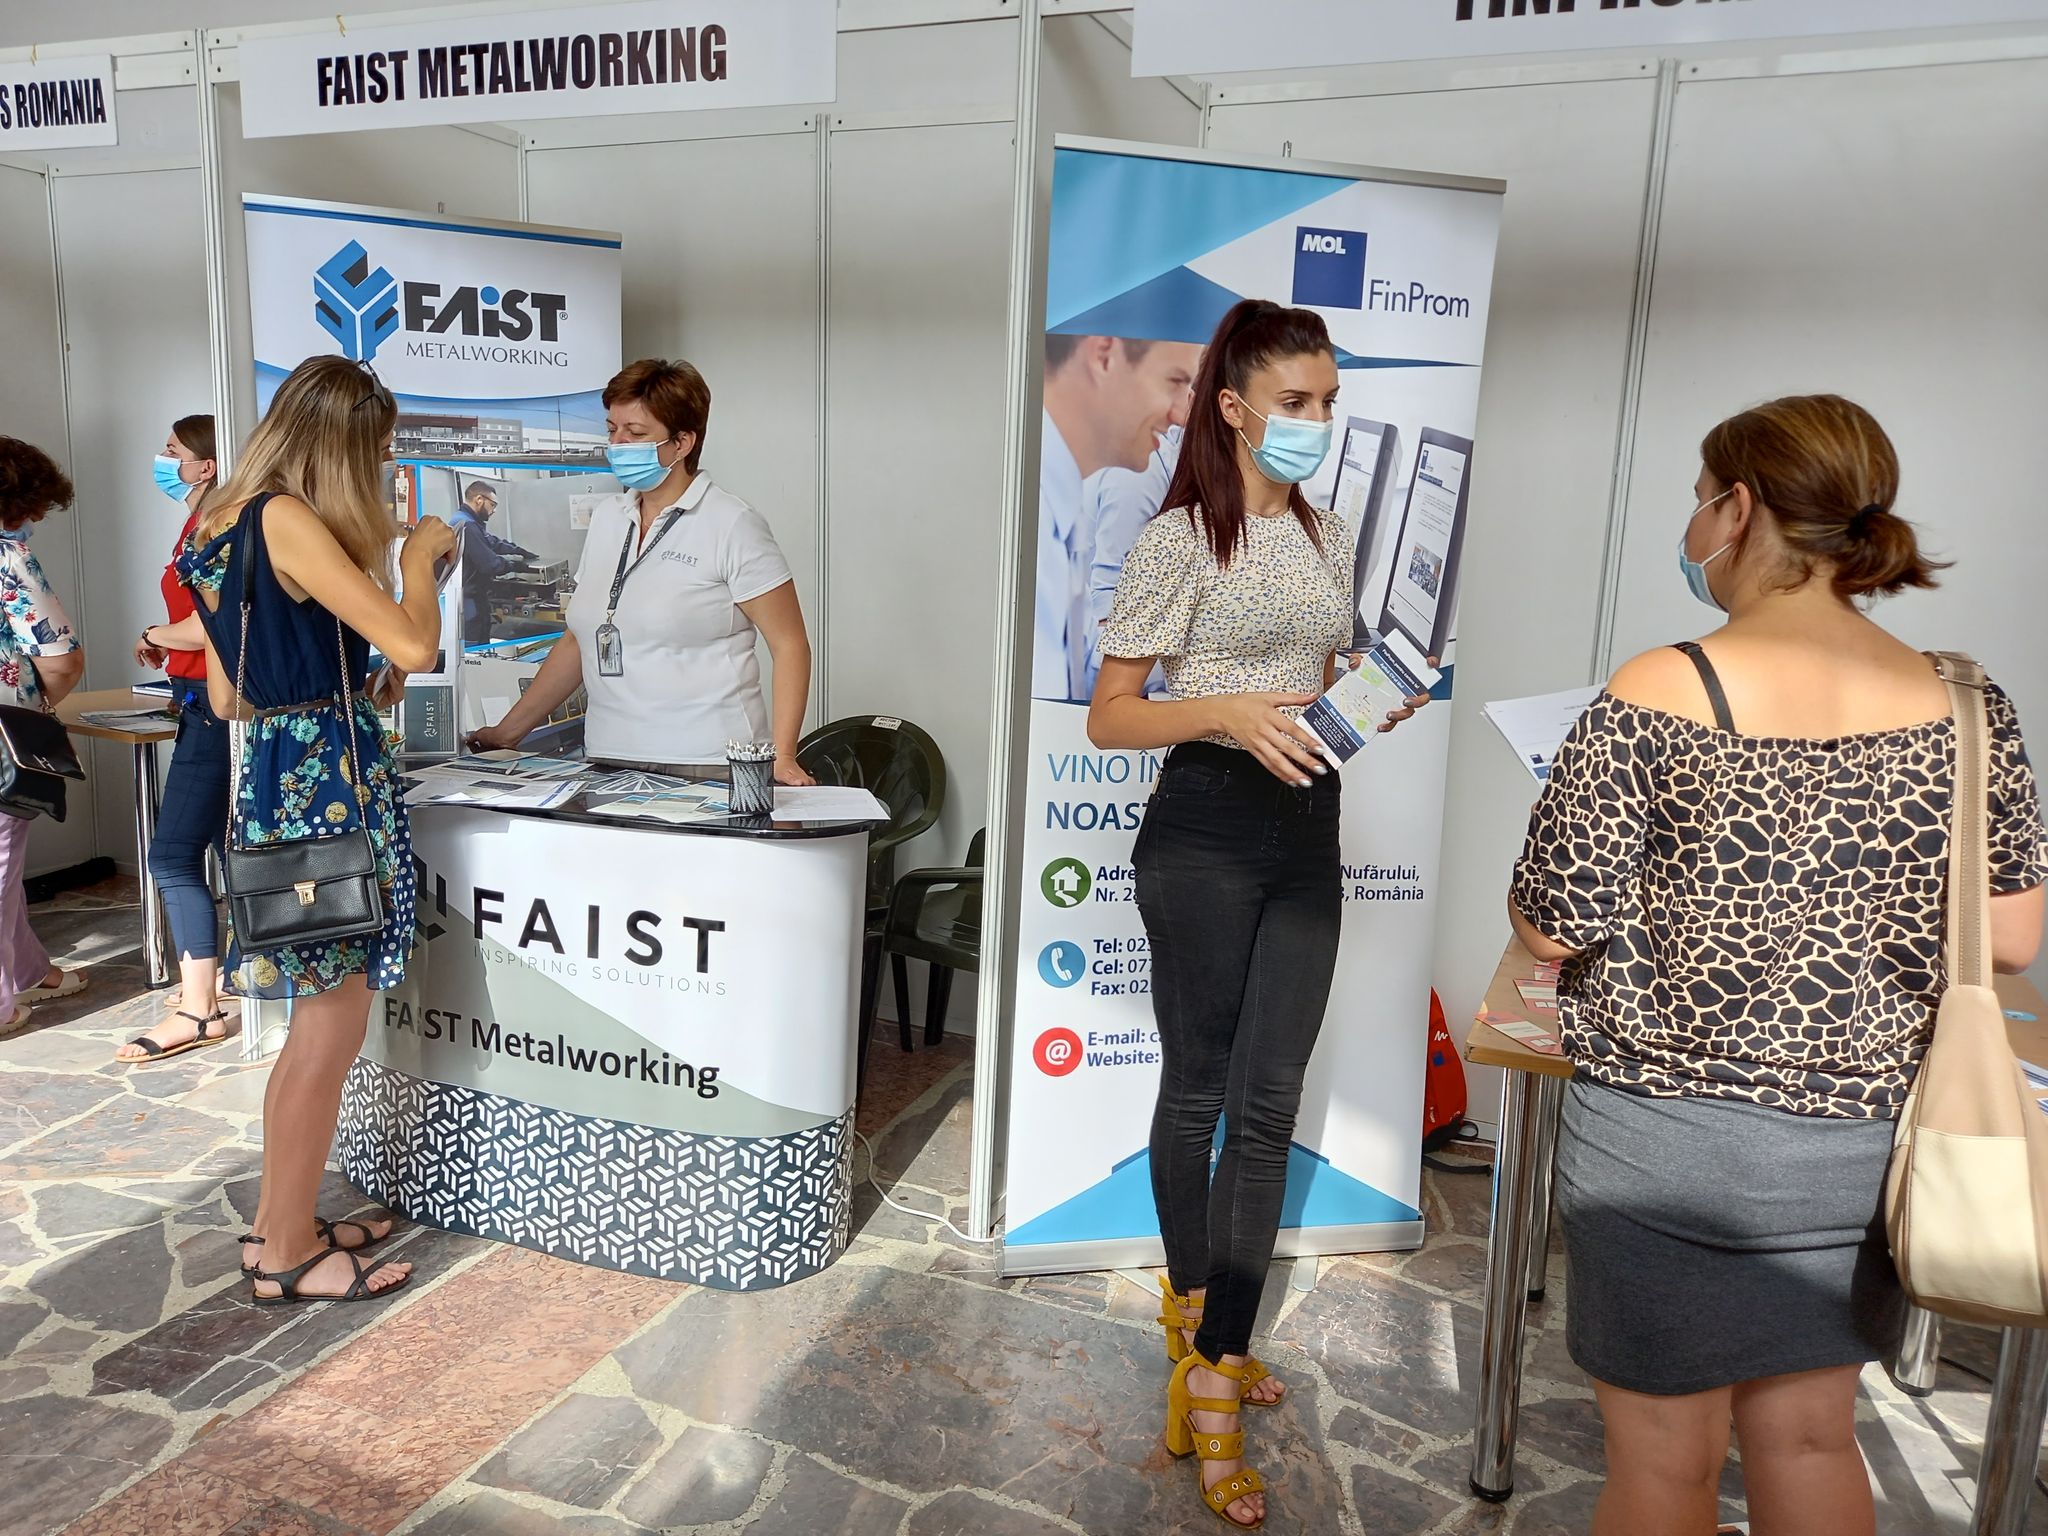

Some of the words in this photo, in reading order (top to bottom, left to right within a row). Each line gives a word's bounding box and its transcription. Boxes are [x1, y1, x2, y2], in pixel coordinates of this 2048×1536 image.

[317, 50, 408, 107] FAIST
[418, 23, 728, 100] METALWORKING
[14, 78, 107, 129] ROMANIA
[1302, 234, 1346, 255] MOL
[1368, 279, 1470, 318] FinProm
[406, 341, 569, 367] METALWORKING
[426, 700, 434, 727] FAIST
[1048, 754, 1130, 783] VINO
[1340, 865, 1420, 882] Nufărului,
[1095, 887, 1118, 902] Nr.
[1354, 885, 1424, 900] România
[473, 886, 726, 973] FAIST
[1093, 937, 1123, 954] Tel:
[473, 945, 578, 977] INSPIRING
[591, 965, 727, 996] SOLUTIONS
[1092, 959, 1124, 975] Cel:
[1090, 981, 1125, 996] Fax:
[1129, 979, 1152, 994] 02
[1087, 1028, 1146, 1046] E-mail:
[471, 1018, 721, 1099] Metalworking
[1086, 1050, 1160, 1067] Website:
